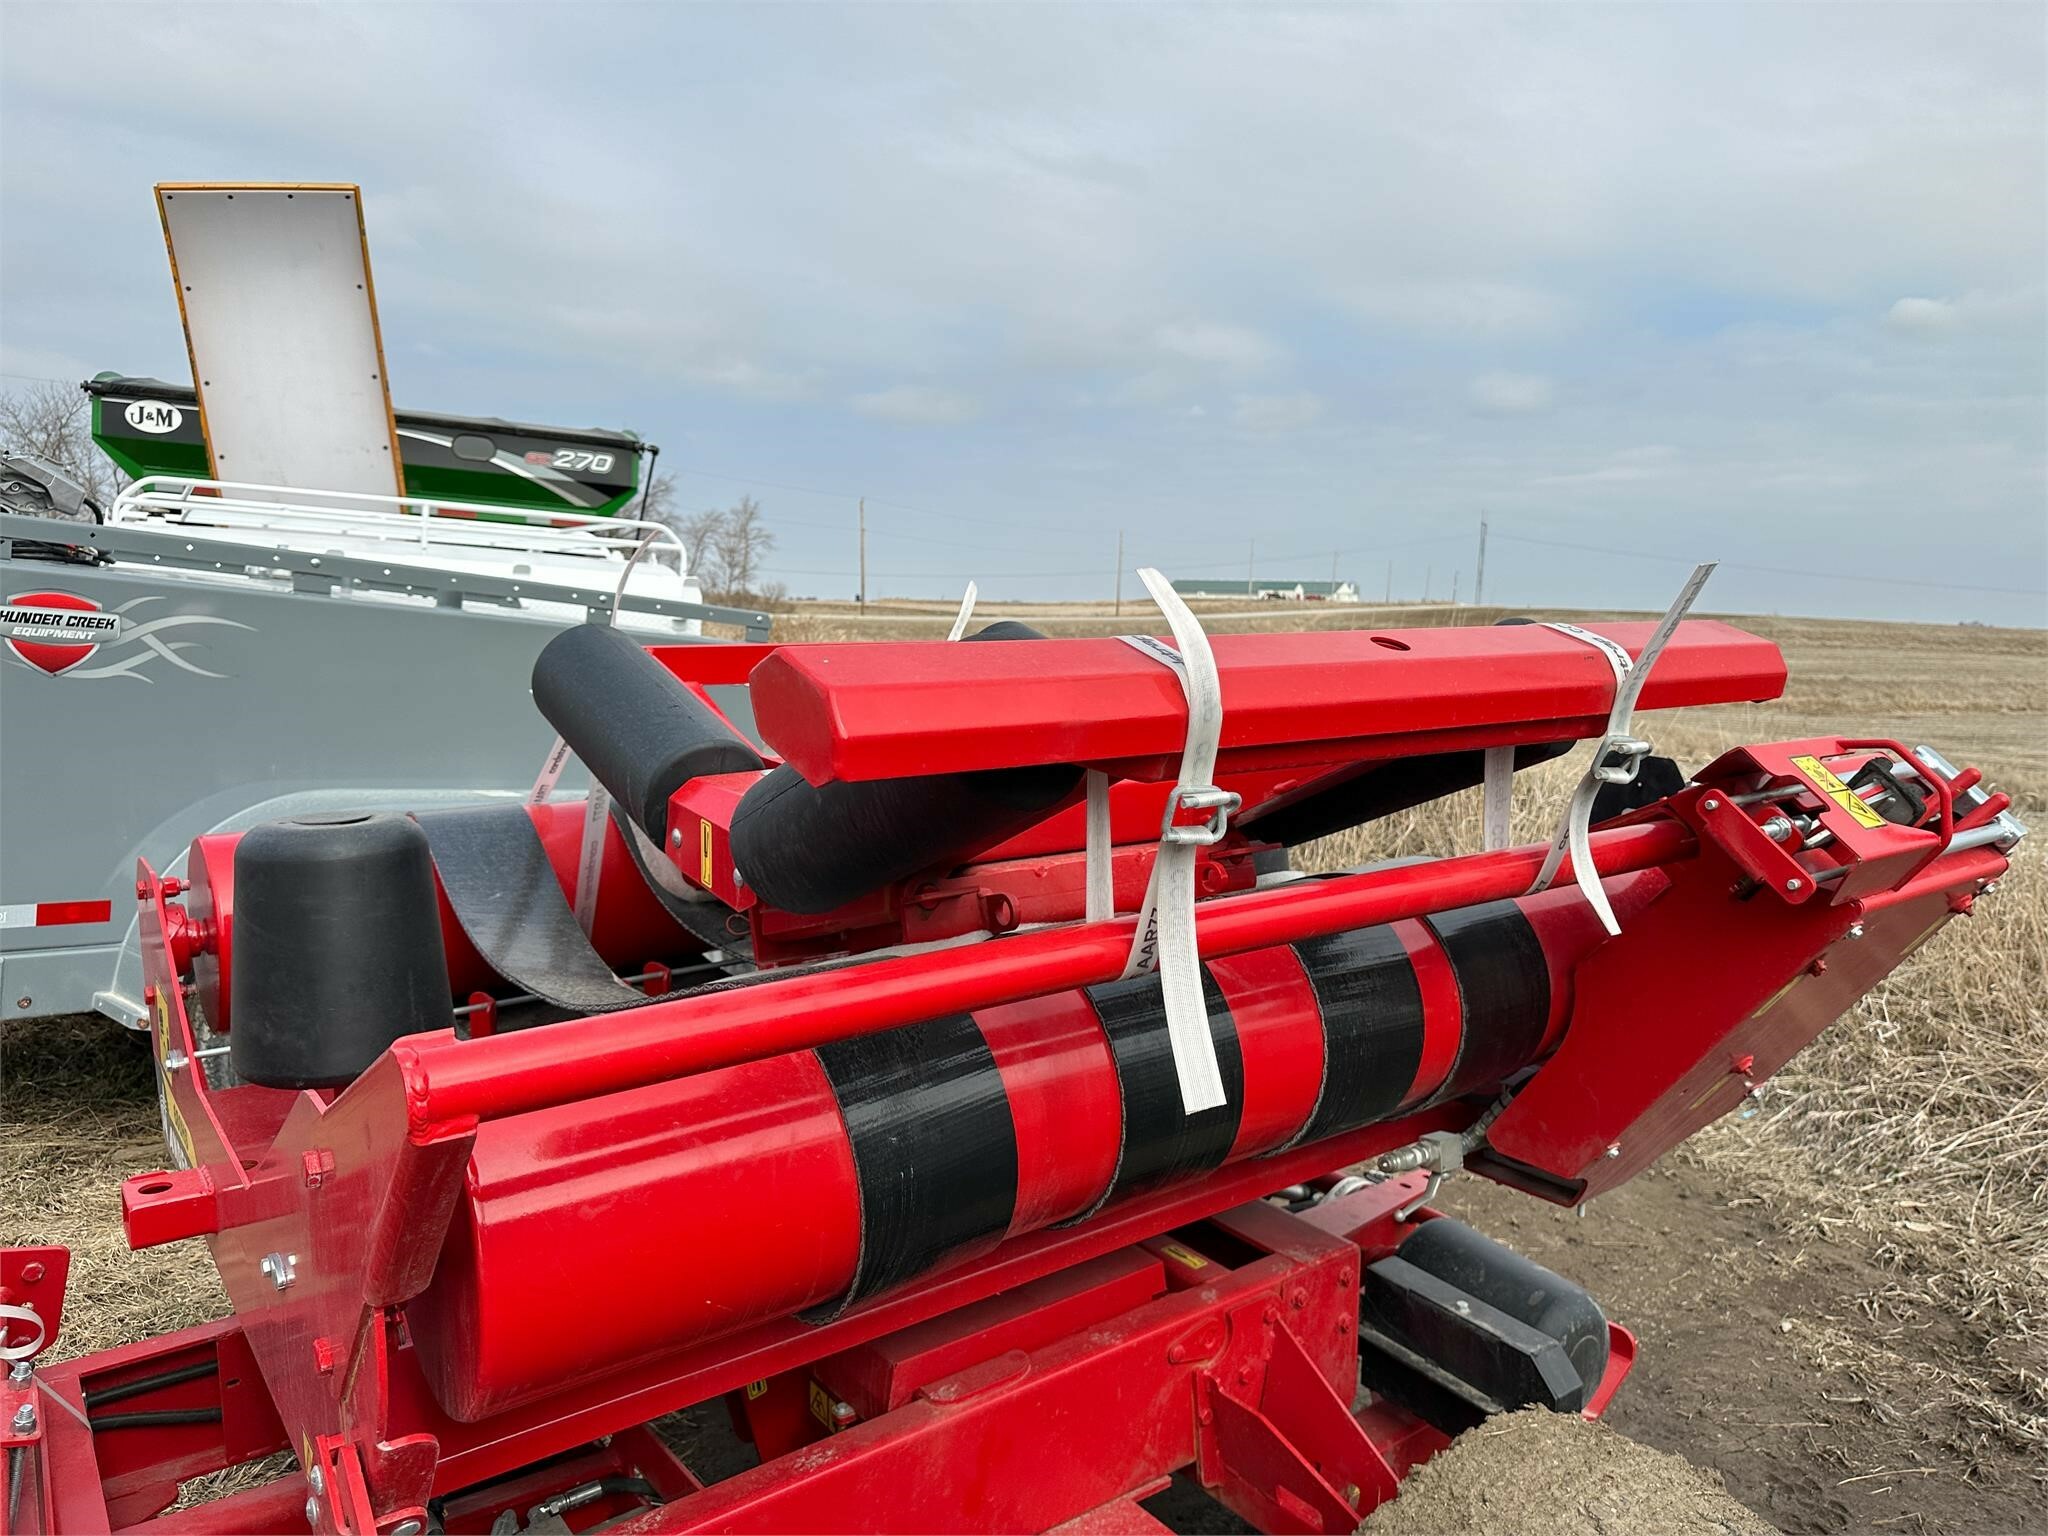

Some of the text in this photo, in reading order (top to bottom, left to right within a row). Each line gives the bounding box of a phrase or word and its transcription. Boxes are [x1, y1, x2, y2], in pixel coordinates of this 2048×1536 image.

[130, 406, 173, 428] J&M
[553, 449, 614, 472] 270
[0, 610, 116, 630] HUNDER CREEK
[11, 626, 97, 640] EQUIPMENT
